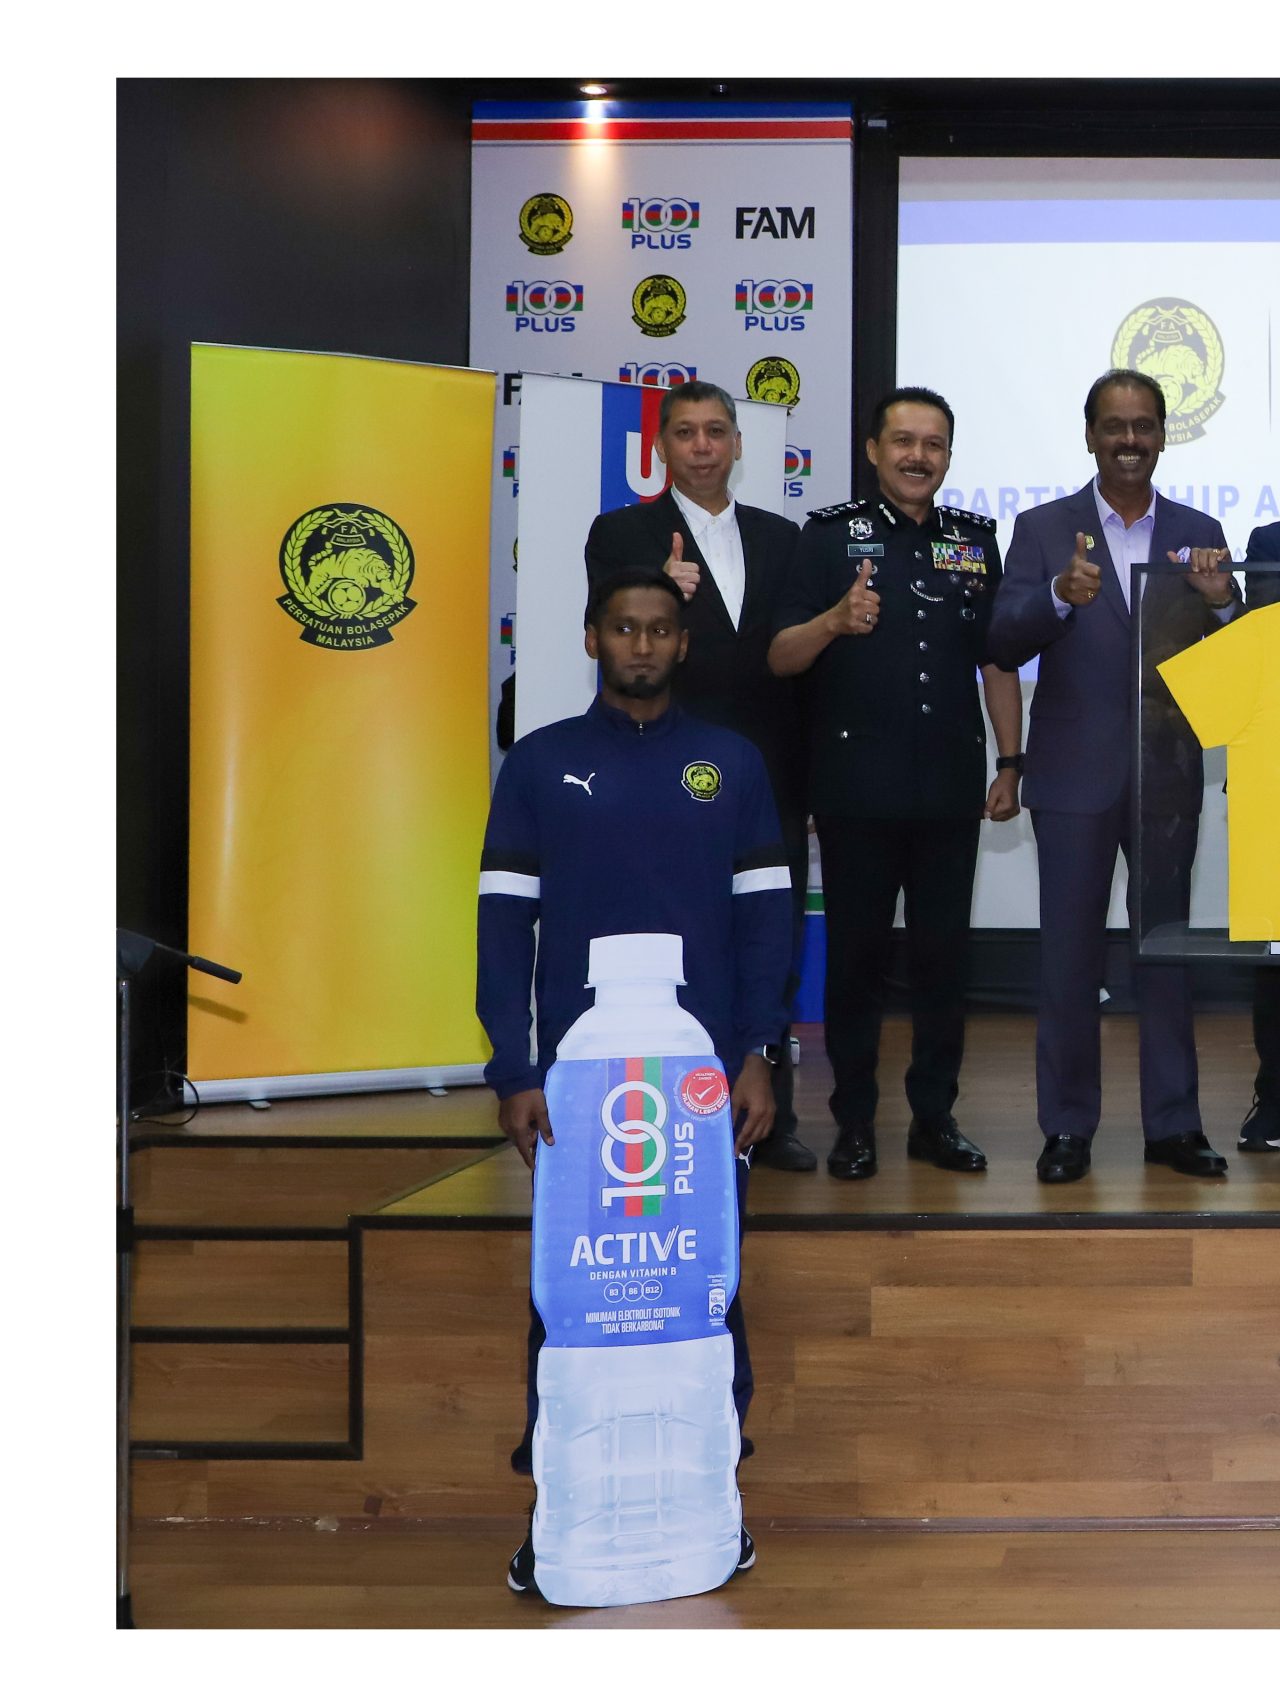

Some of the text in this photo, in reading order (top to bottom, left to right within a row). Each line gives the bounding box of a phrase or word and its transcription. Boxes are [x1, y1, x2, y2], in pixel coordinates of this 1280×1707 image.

[627, 197, 694, 233] 100
[735, 206, 816, 240] FAM
[631, 233, 692, 250] PLUS
[511, 279, 578, 316] 100
[741, 278, 807, 315] 100
[515, 316, 576, 333] PLUS
[744, 315, 805, 332] PLUS
[1168, 397, 1222, 432] BOLASEPAK
[283, 597, 410, 635] PERSATUAN BOLASEPAK
[315, 634, 375, 648] MALAYSIA
[601, 1080, 668, 1207] 100
[674, 1121, 694, 1195] PLUS
[569, 1225, 697, 1267] ACTIVE
[590, 1266, 677, 1281] DENGAN VITAMIN B
[609, 1285, 660, 1296] B3 B6 B12
[585, 1306, 681, 1324] MINUMAN ELEKTROLIT ISOTONIK
[602, 1321, 665, 1334] TIDAK BERKARBONAT
